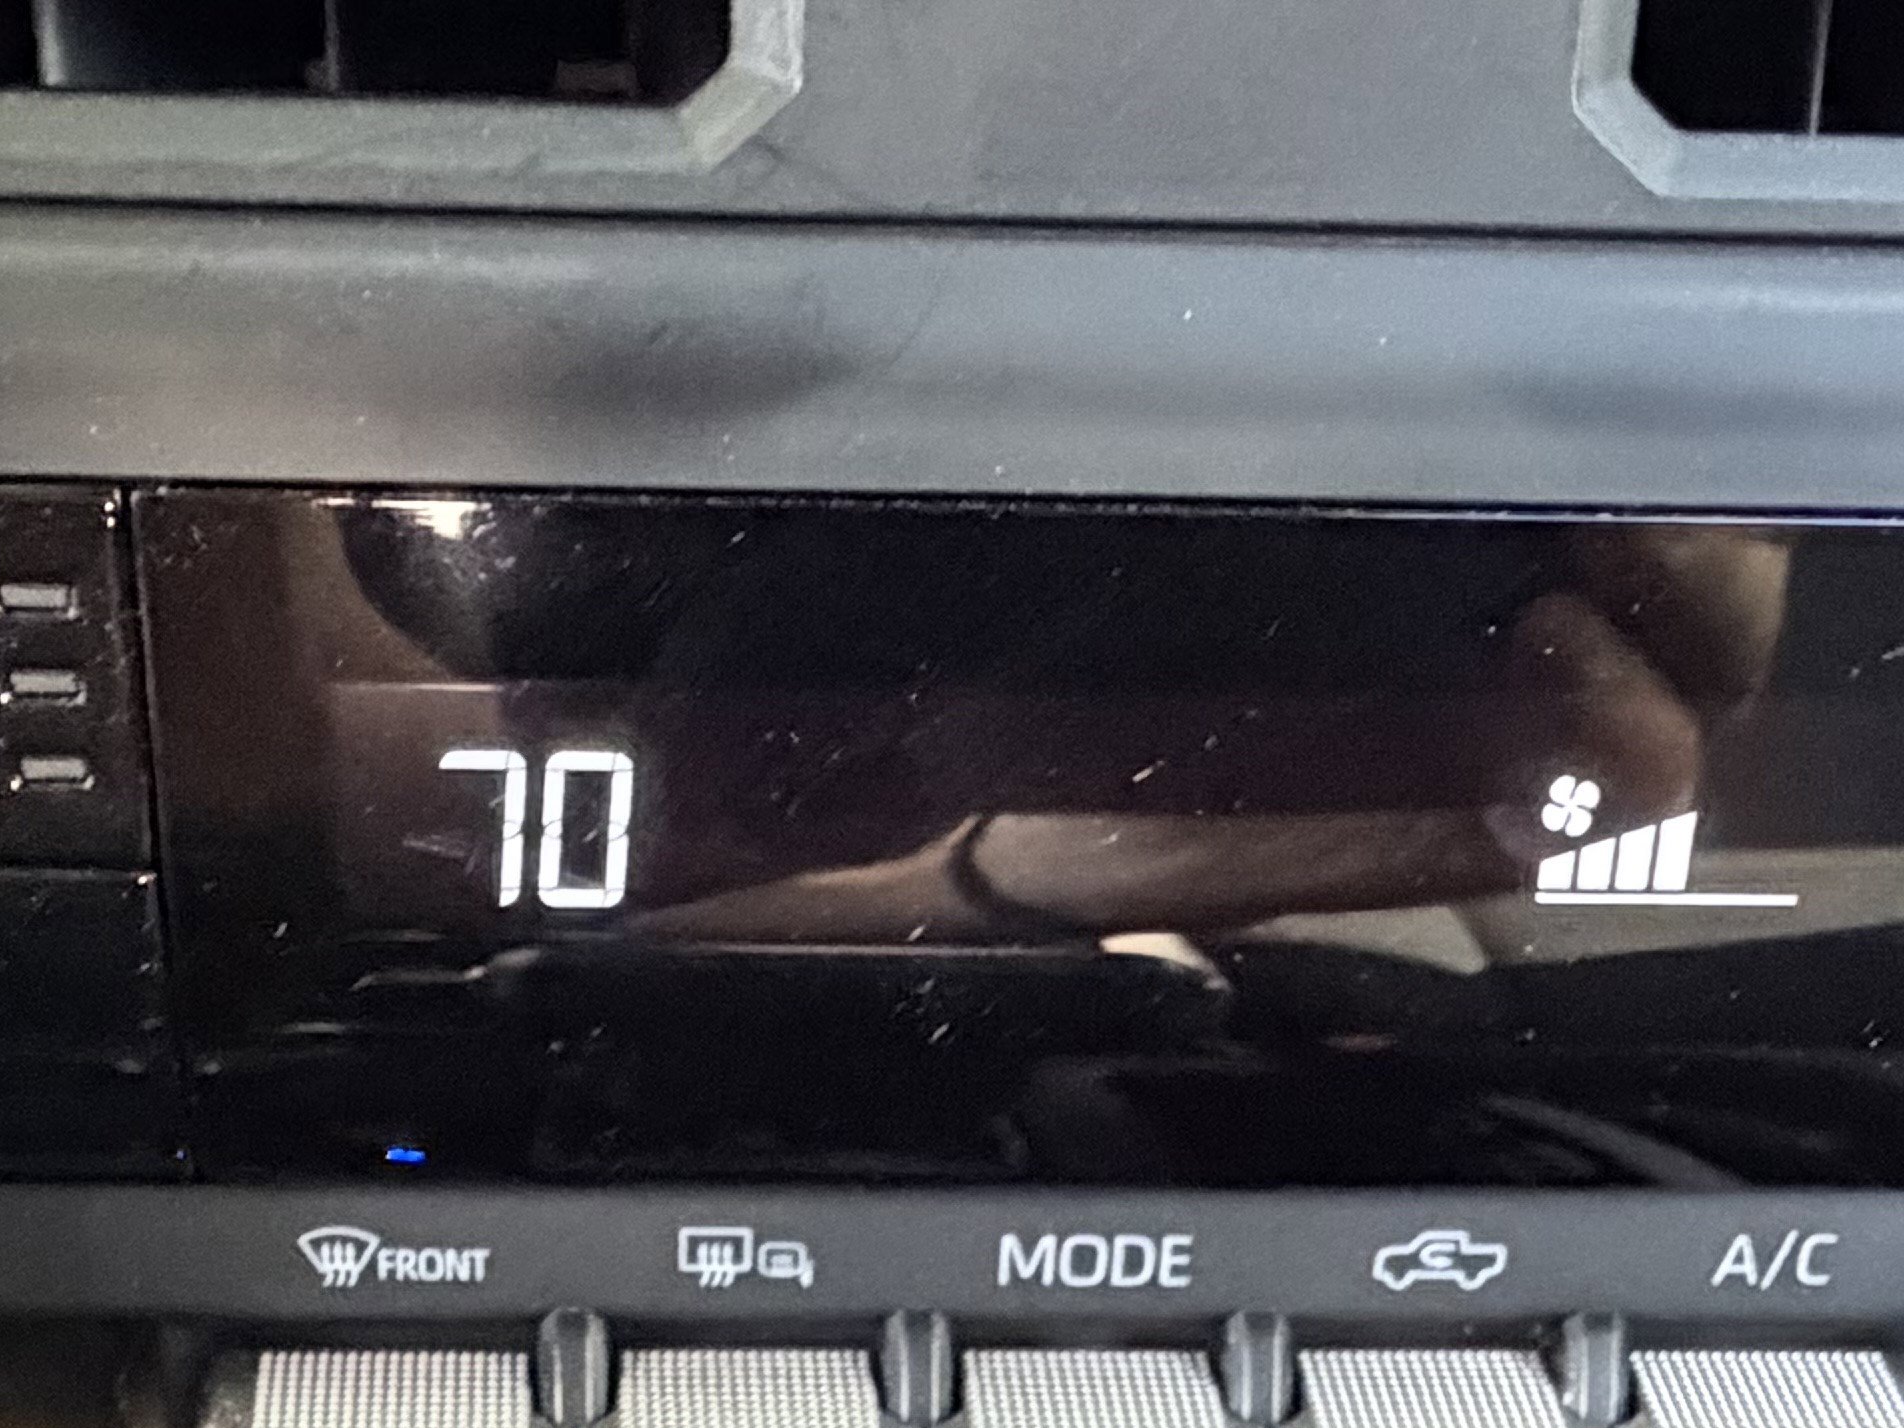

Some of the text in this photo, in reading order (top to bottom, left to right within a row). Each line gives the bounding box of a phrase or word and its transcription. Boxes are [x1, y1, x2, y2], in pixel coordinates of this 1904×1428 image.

[437, 746, 634, 911] 70
[377, 1246, 490, 1284] FRONT
[996, 1231, 1194, 1290] MODE
[1711, 1229, 1838, 1290] A/C
